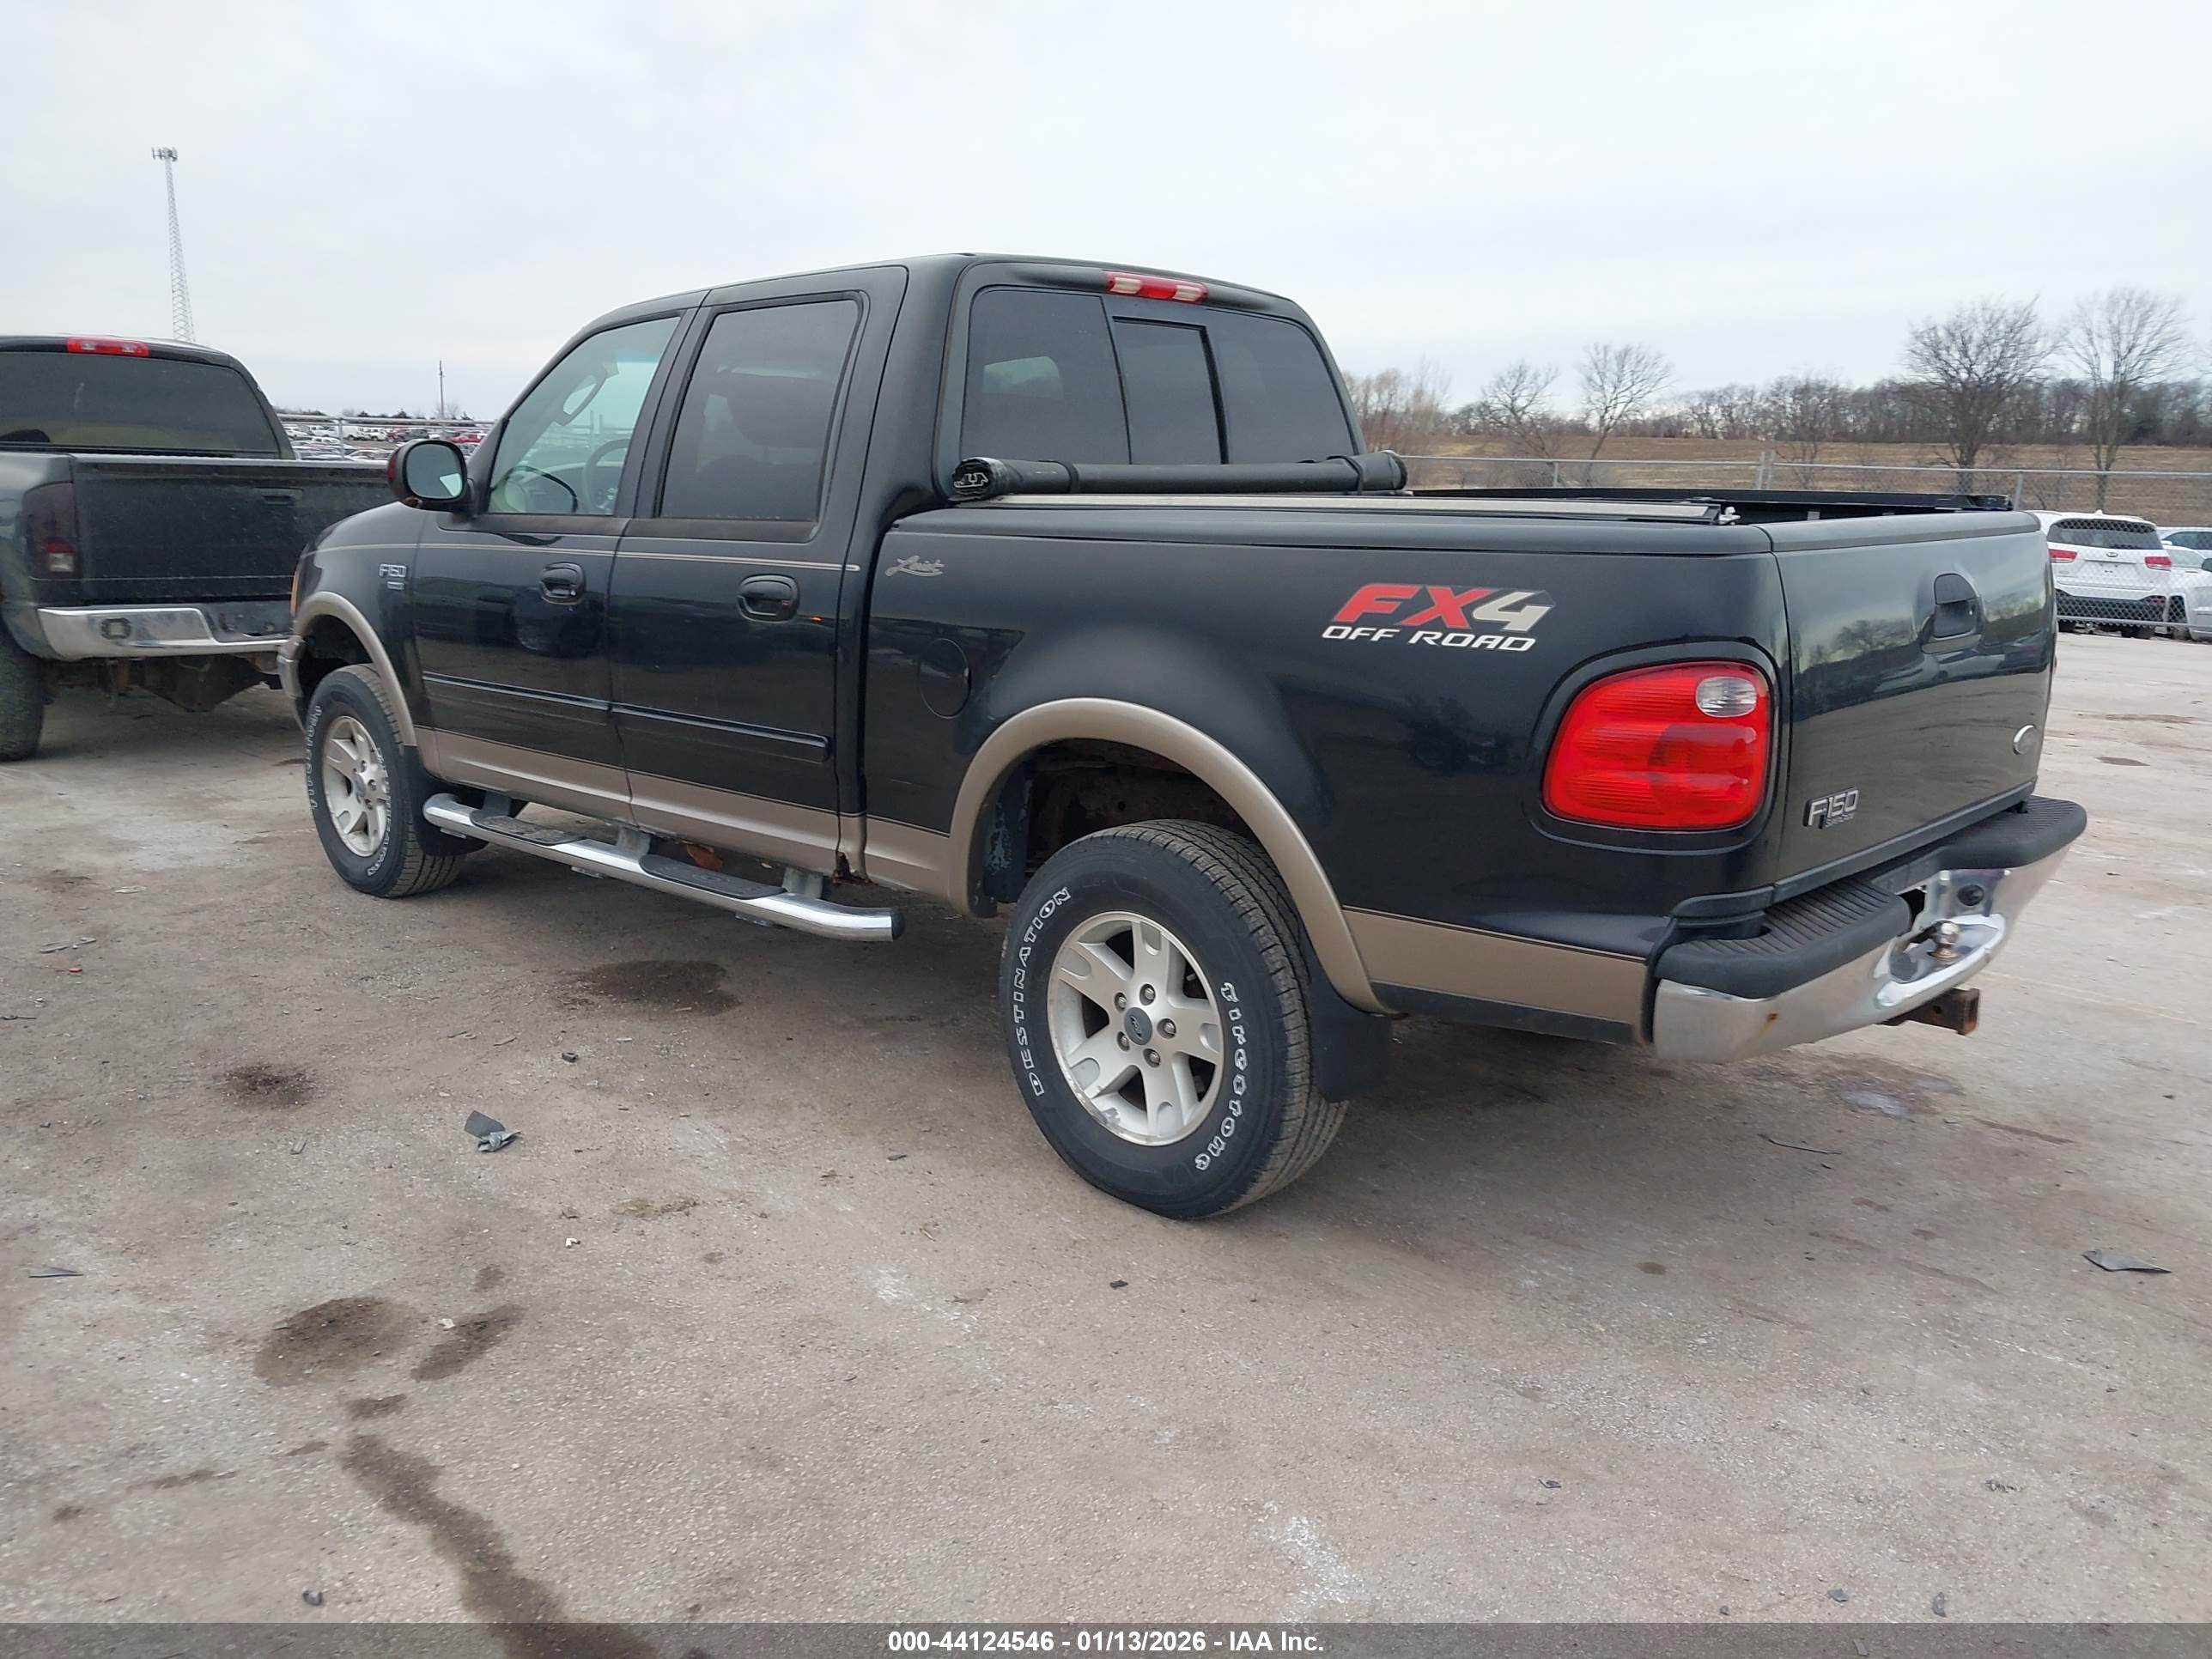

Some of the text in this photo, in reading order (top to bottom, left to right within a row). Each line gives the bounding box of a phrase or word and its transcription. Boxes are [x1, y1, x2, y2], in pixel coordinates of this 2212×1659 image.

[1333, 584, 1552, 632] FX4
[1322, 625, 1536, 652] OFF ROAD
[1012, 886, 1072, 1097] DESTINATION
